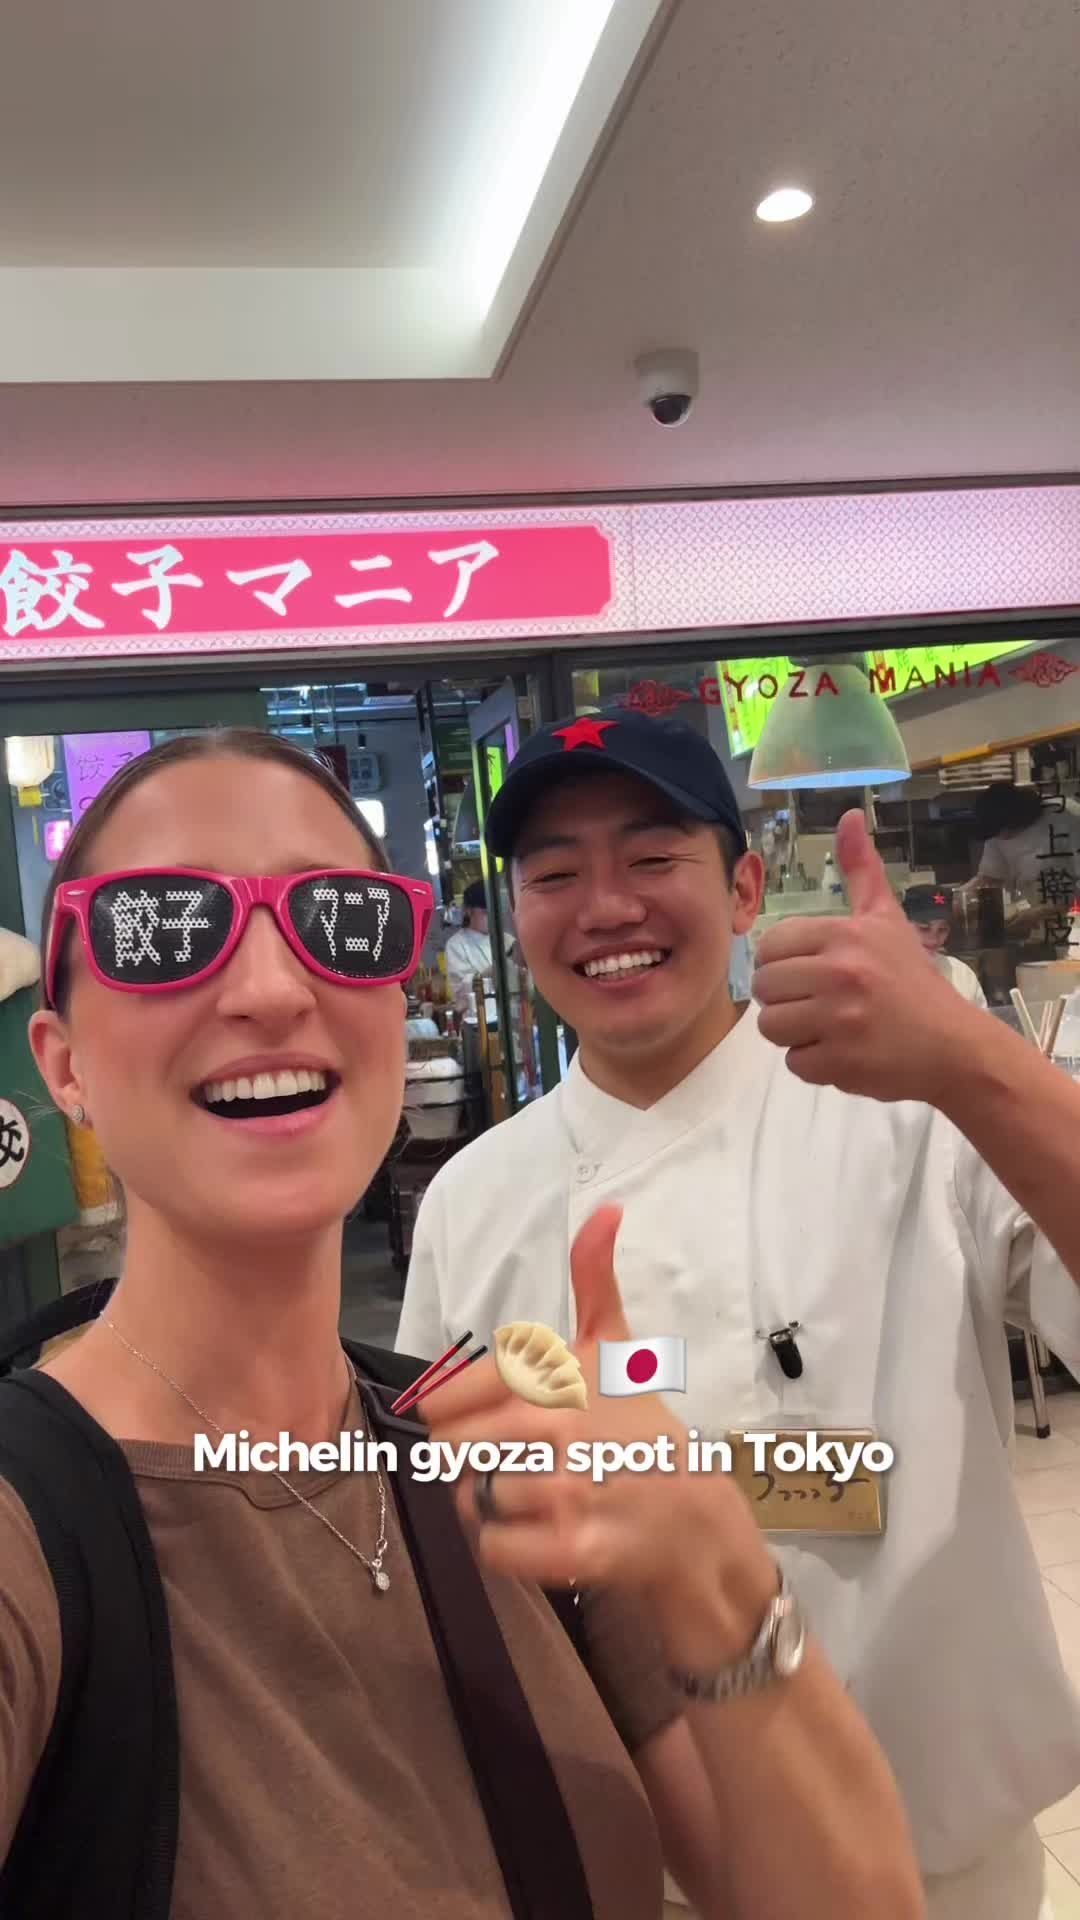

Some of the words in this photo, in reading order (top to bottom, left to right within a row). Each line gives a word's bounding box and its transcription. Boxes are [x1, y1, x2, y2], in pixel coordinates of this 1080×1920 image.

[0, 540, 499, 636] 餃子マニア
[699, 670, 839, 705] GYOZA
[868, 660, 1003, 694] MANIA
[110, 889, 209, 968] 餃子
[313, 887, 390, 961] マニア
